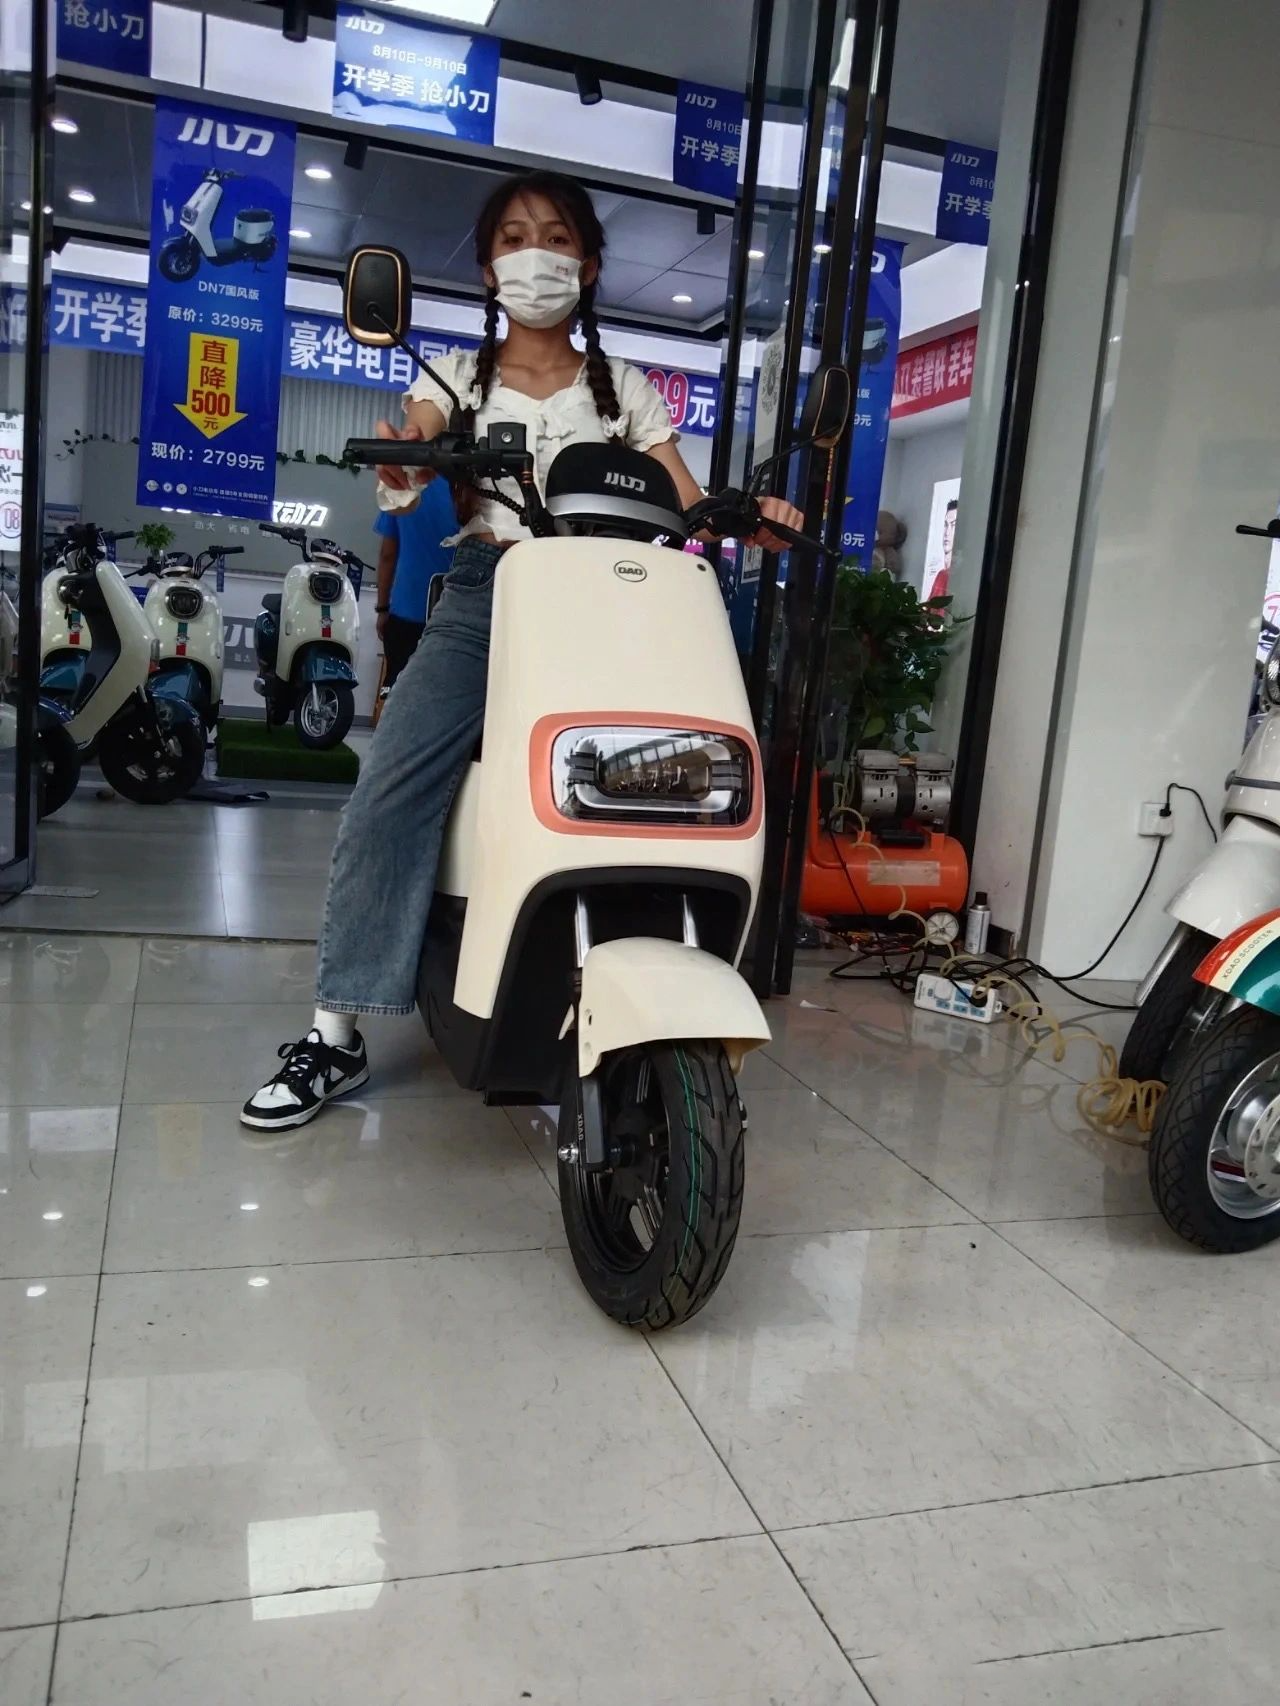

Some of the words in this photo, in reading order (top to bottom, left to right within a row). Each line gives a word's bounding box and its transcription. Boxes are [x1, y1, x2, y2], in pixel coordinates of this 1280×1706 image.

[64, 0, 144, 40] 抢小刀
[372, 45, 467, 75] 8月10日-9月10日
[342, 63, 415, 97] 开学季
[420, 78, 490, 113] 抢小刀
[680, 135, 739, 167] 开学季
[198, 280, 260, 301] DN7国风版
[191, 388, 231, 417] 500
[203, 416, 219, 430] 元
